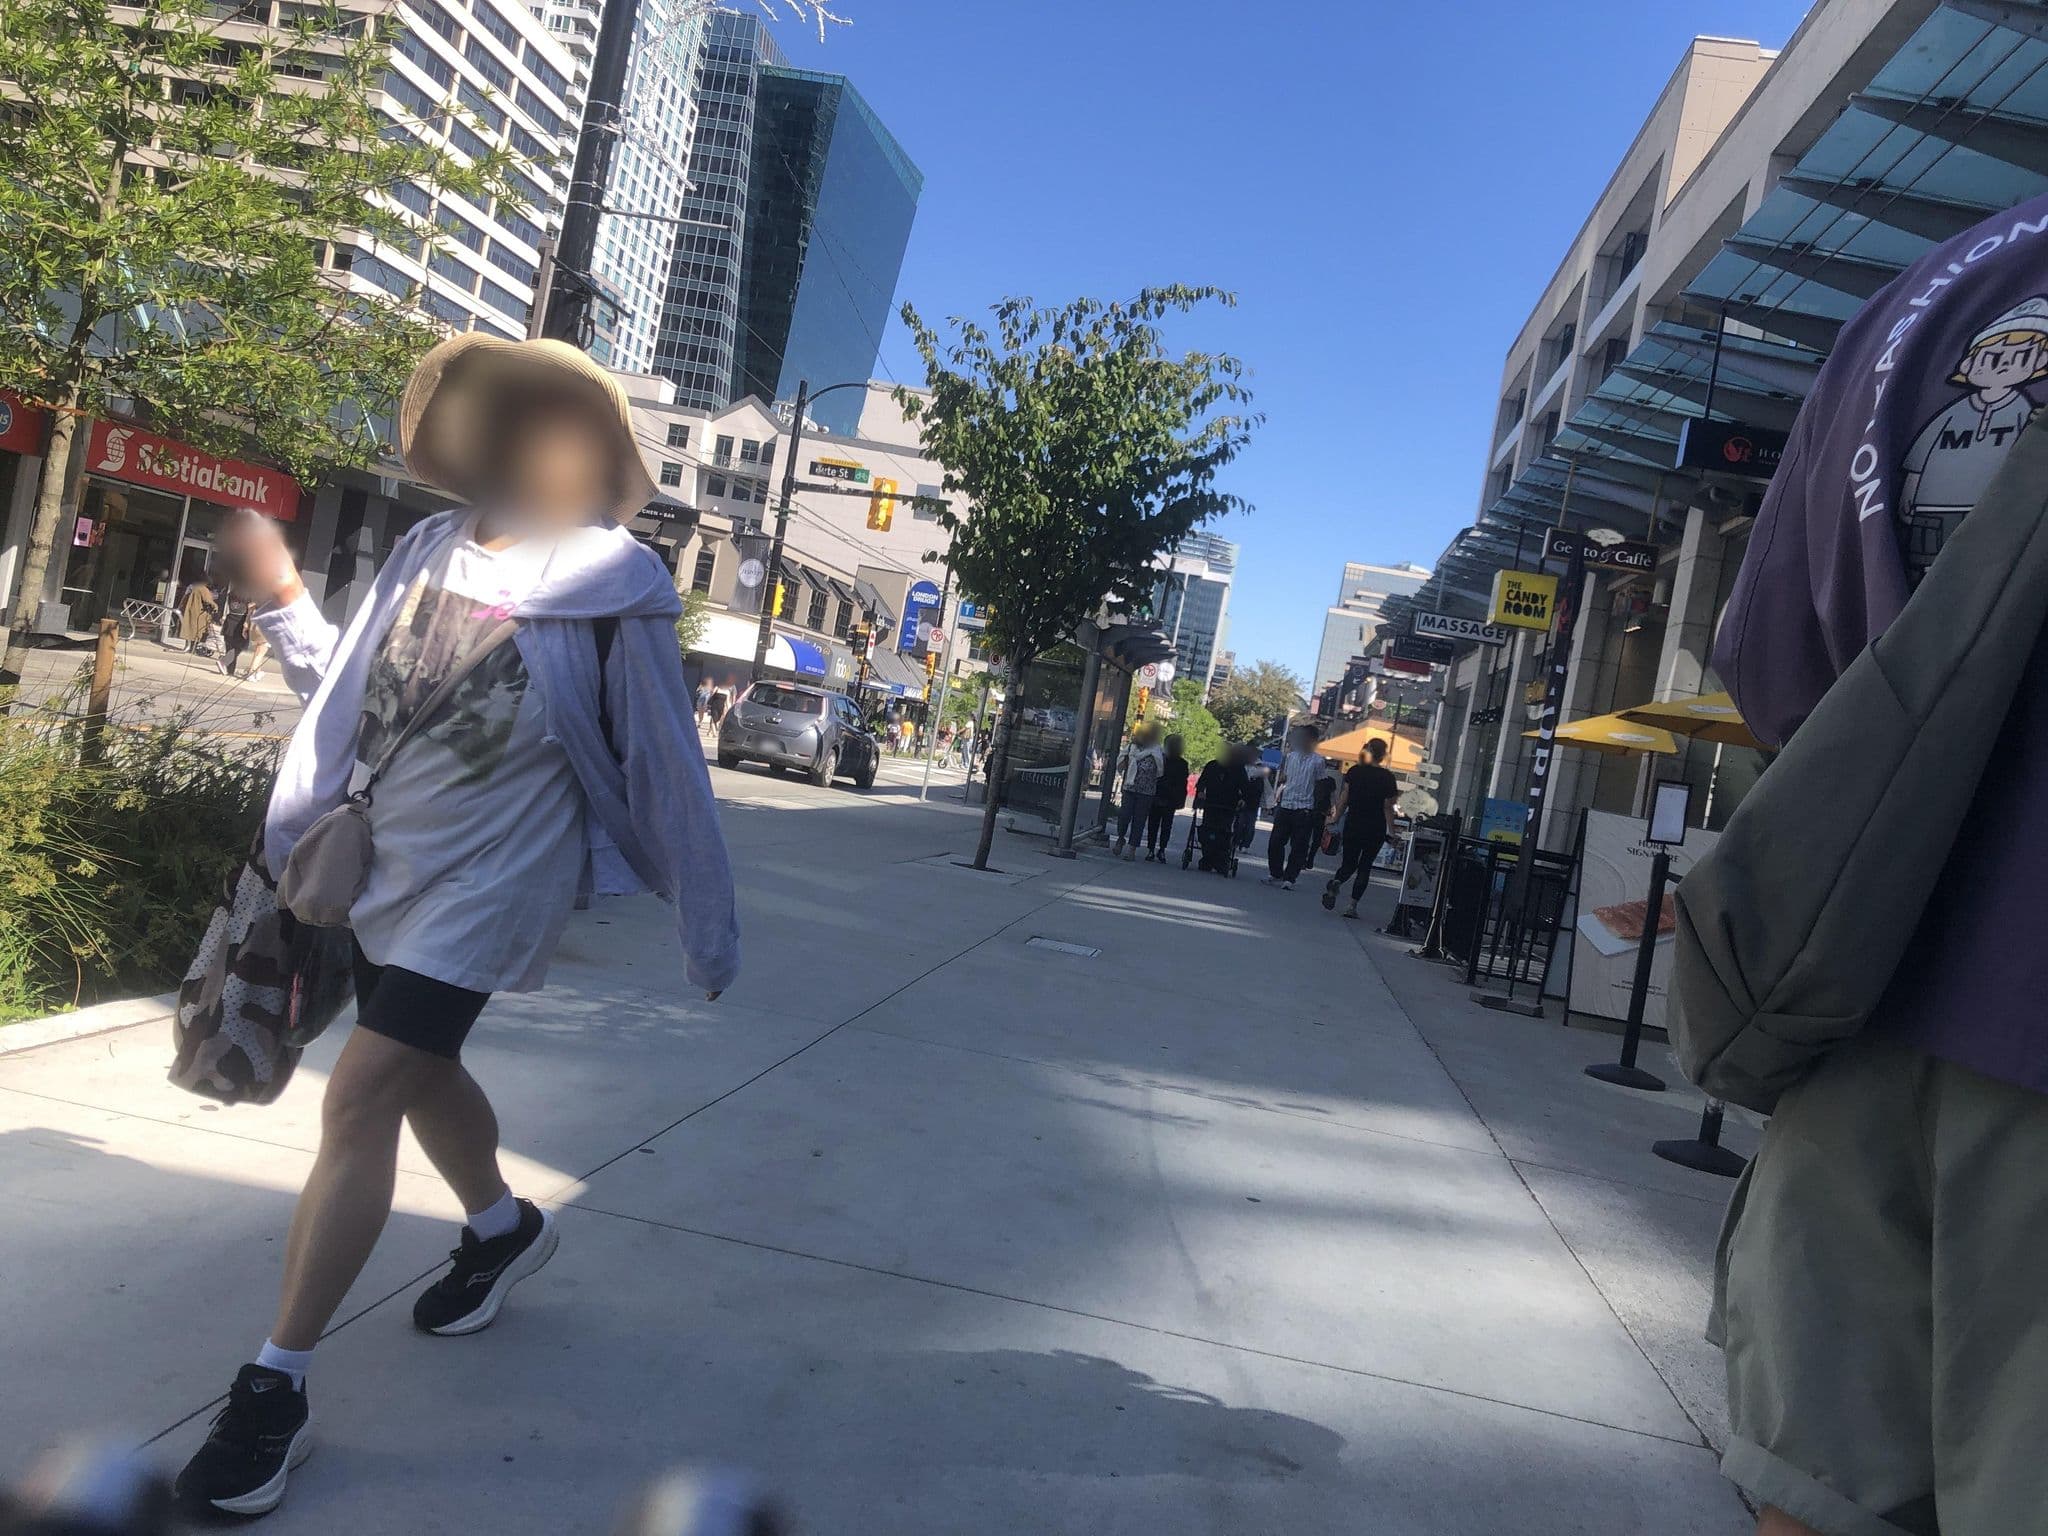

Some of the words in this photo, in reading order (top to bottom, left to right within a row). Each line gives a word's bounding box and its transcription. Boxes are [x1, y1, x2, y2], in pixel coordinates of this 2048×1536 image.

[136, 443, 269, 504] Scotiabank
[838, 468, 849, 479] St
[1553, 540, 1598, 559] Geto
[1507, 580, 1522, 590] THE
[911, 590, 939, 601] LONDON
[913, 596, 936, 605] DRUGS
[1506, 589, 1548, 606] CANDY
[1503, 601, 1546, 619] ROOM
[1421, 614, 1505, 641] MASSAGE
